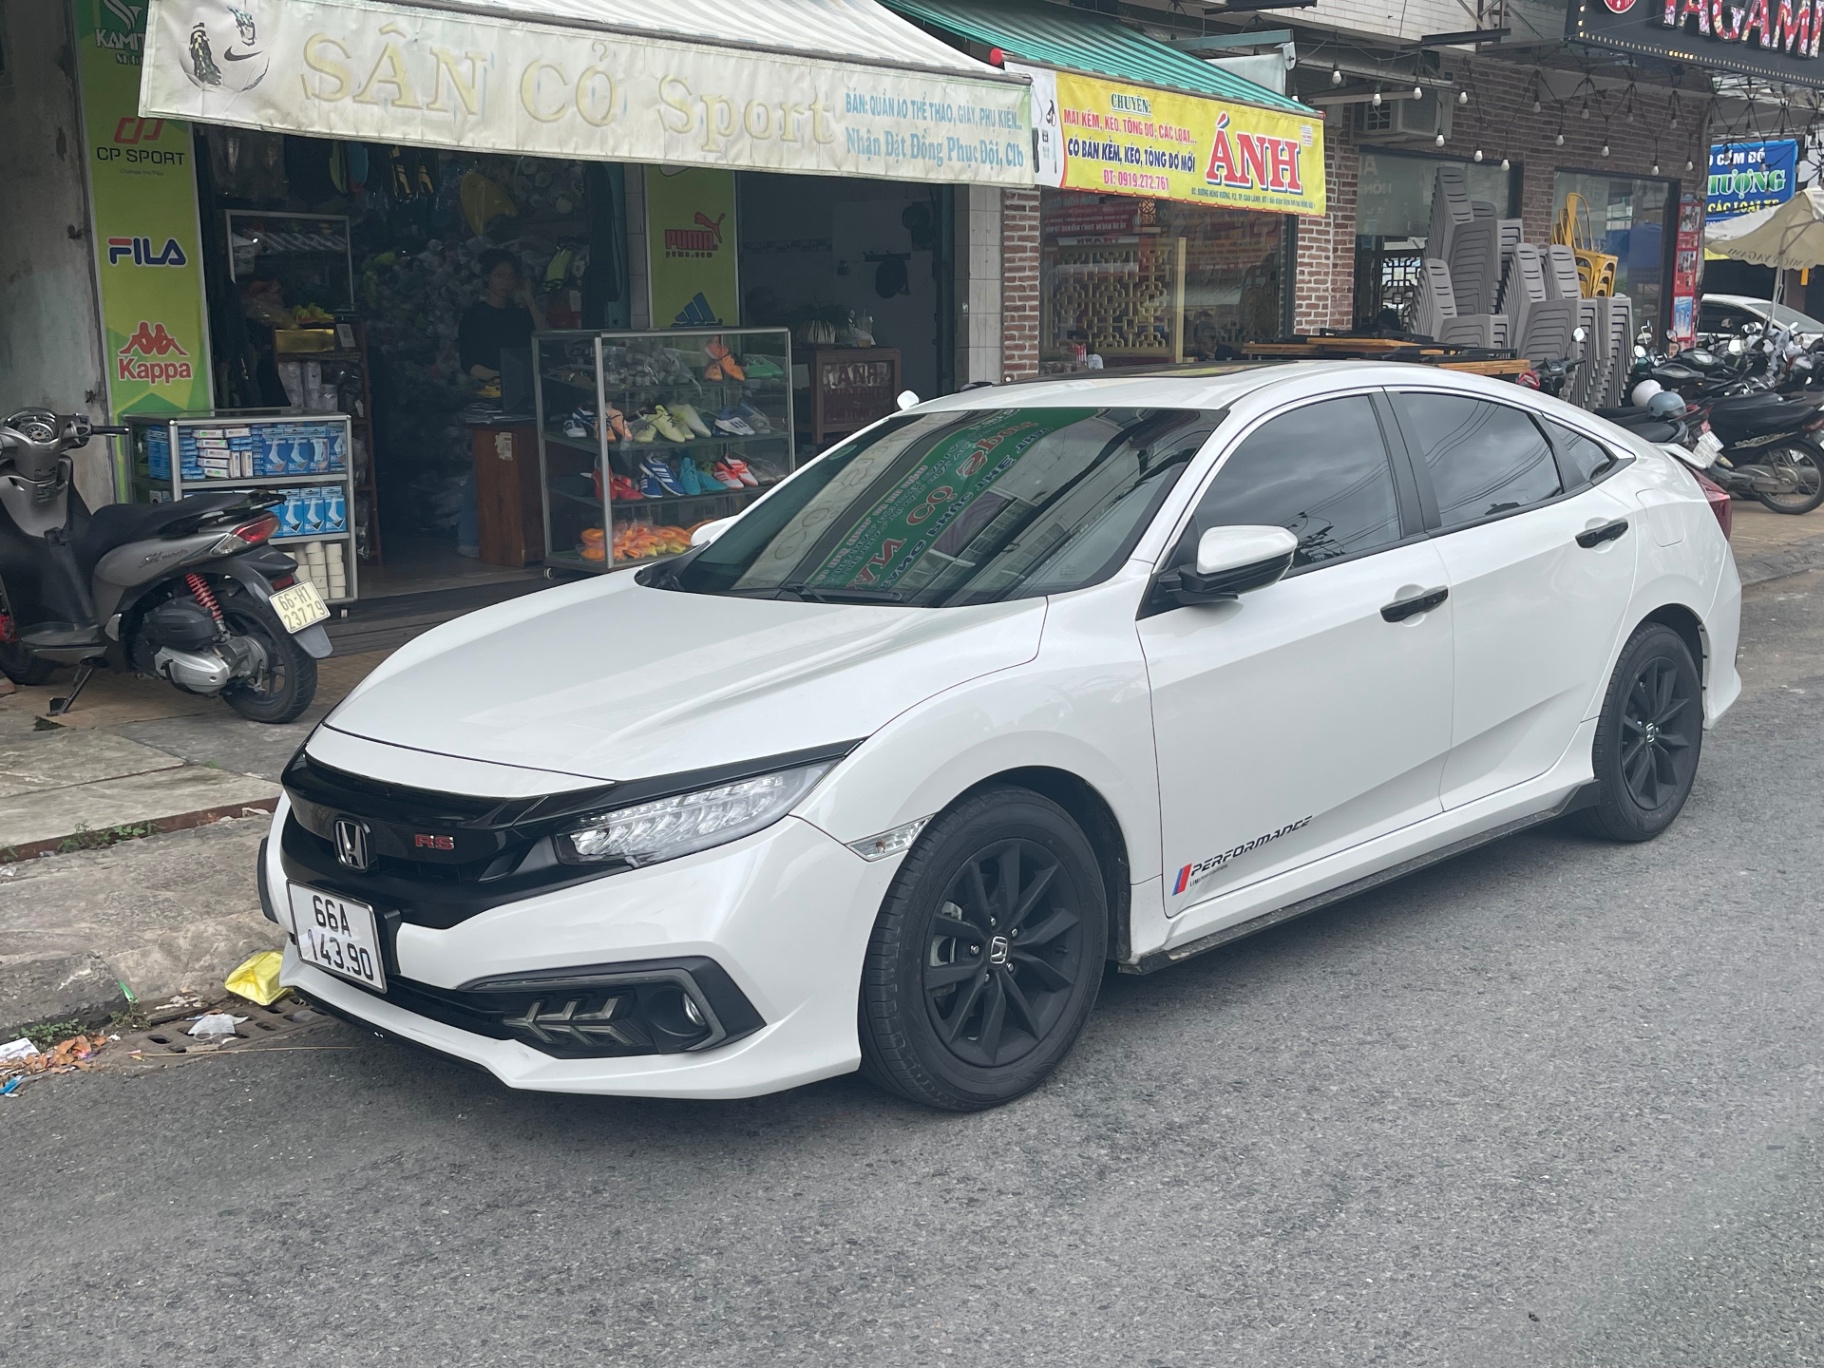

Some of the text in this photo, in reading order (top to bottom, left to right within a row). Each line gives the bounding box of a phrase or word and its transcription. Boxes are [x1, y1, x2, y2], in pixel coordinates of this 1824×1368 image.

[300, 21, 835, 154] SÂN CỎ Sport
[1111, 93, 1152, 114] CHUYÊN:
[97, 147, 186, 166] CP SPORT
[845, 127, 881, 162] Nhận
[884, 130, 907, 164] Đặt
[909, 128, 944, 168] Đồng
[946, 136, 979, 168] Phục
[1067, 133, 1080, 157] CÓ
[1081, 136, 1100, 160] BÁN
[1123, 141, 1143, 168] KÉO,
[1144, 145, 1167, 169] TÔNG
[1205, 111, 1303, 195] ÁNH
[1103, 169, 1170, 192] ĐT: 0919.272.761
[108, 237, 188, 267] FILA
[664, 229, 714, 250] PUMA
[118, 357, 192, 385] Kappa
[415, 833, 455, 850] RS
[1190, 814, 1313, 877] PERFORMANCE
[312, 894, 353, 939] 66A
[307, 928, 375, 981] 143.90
